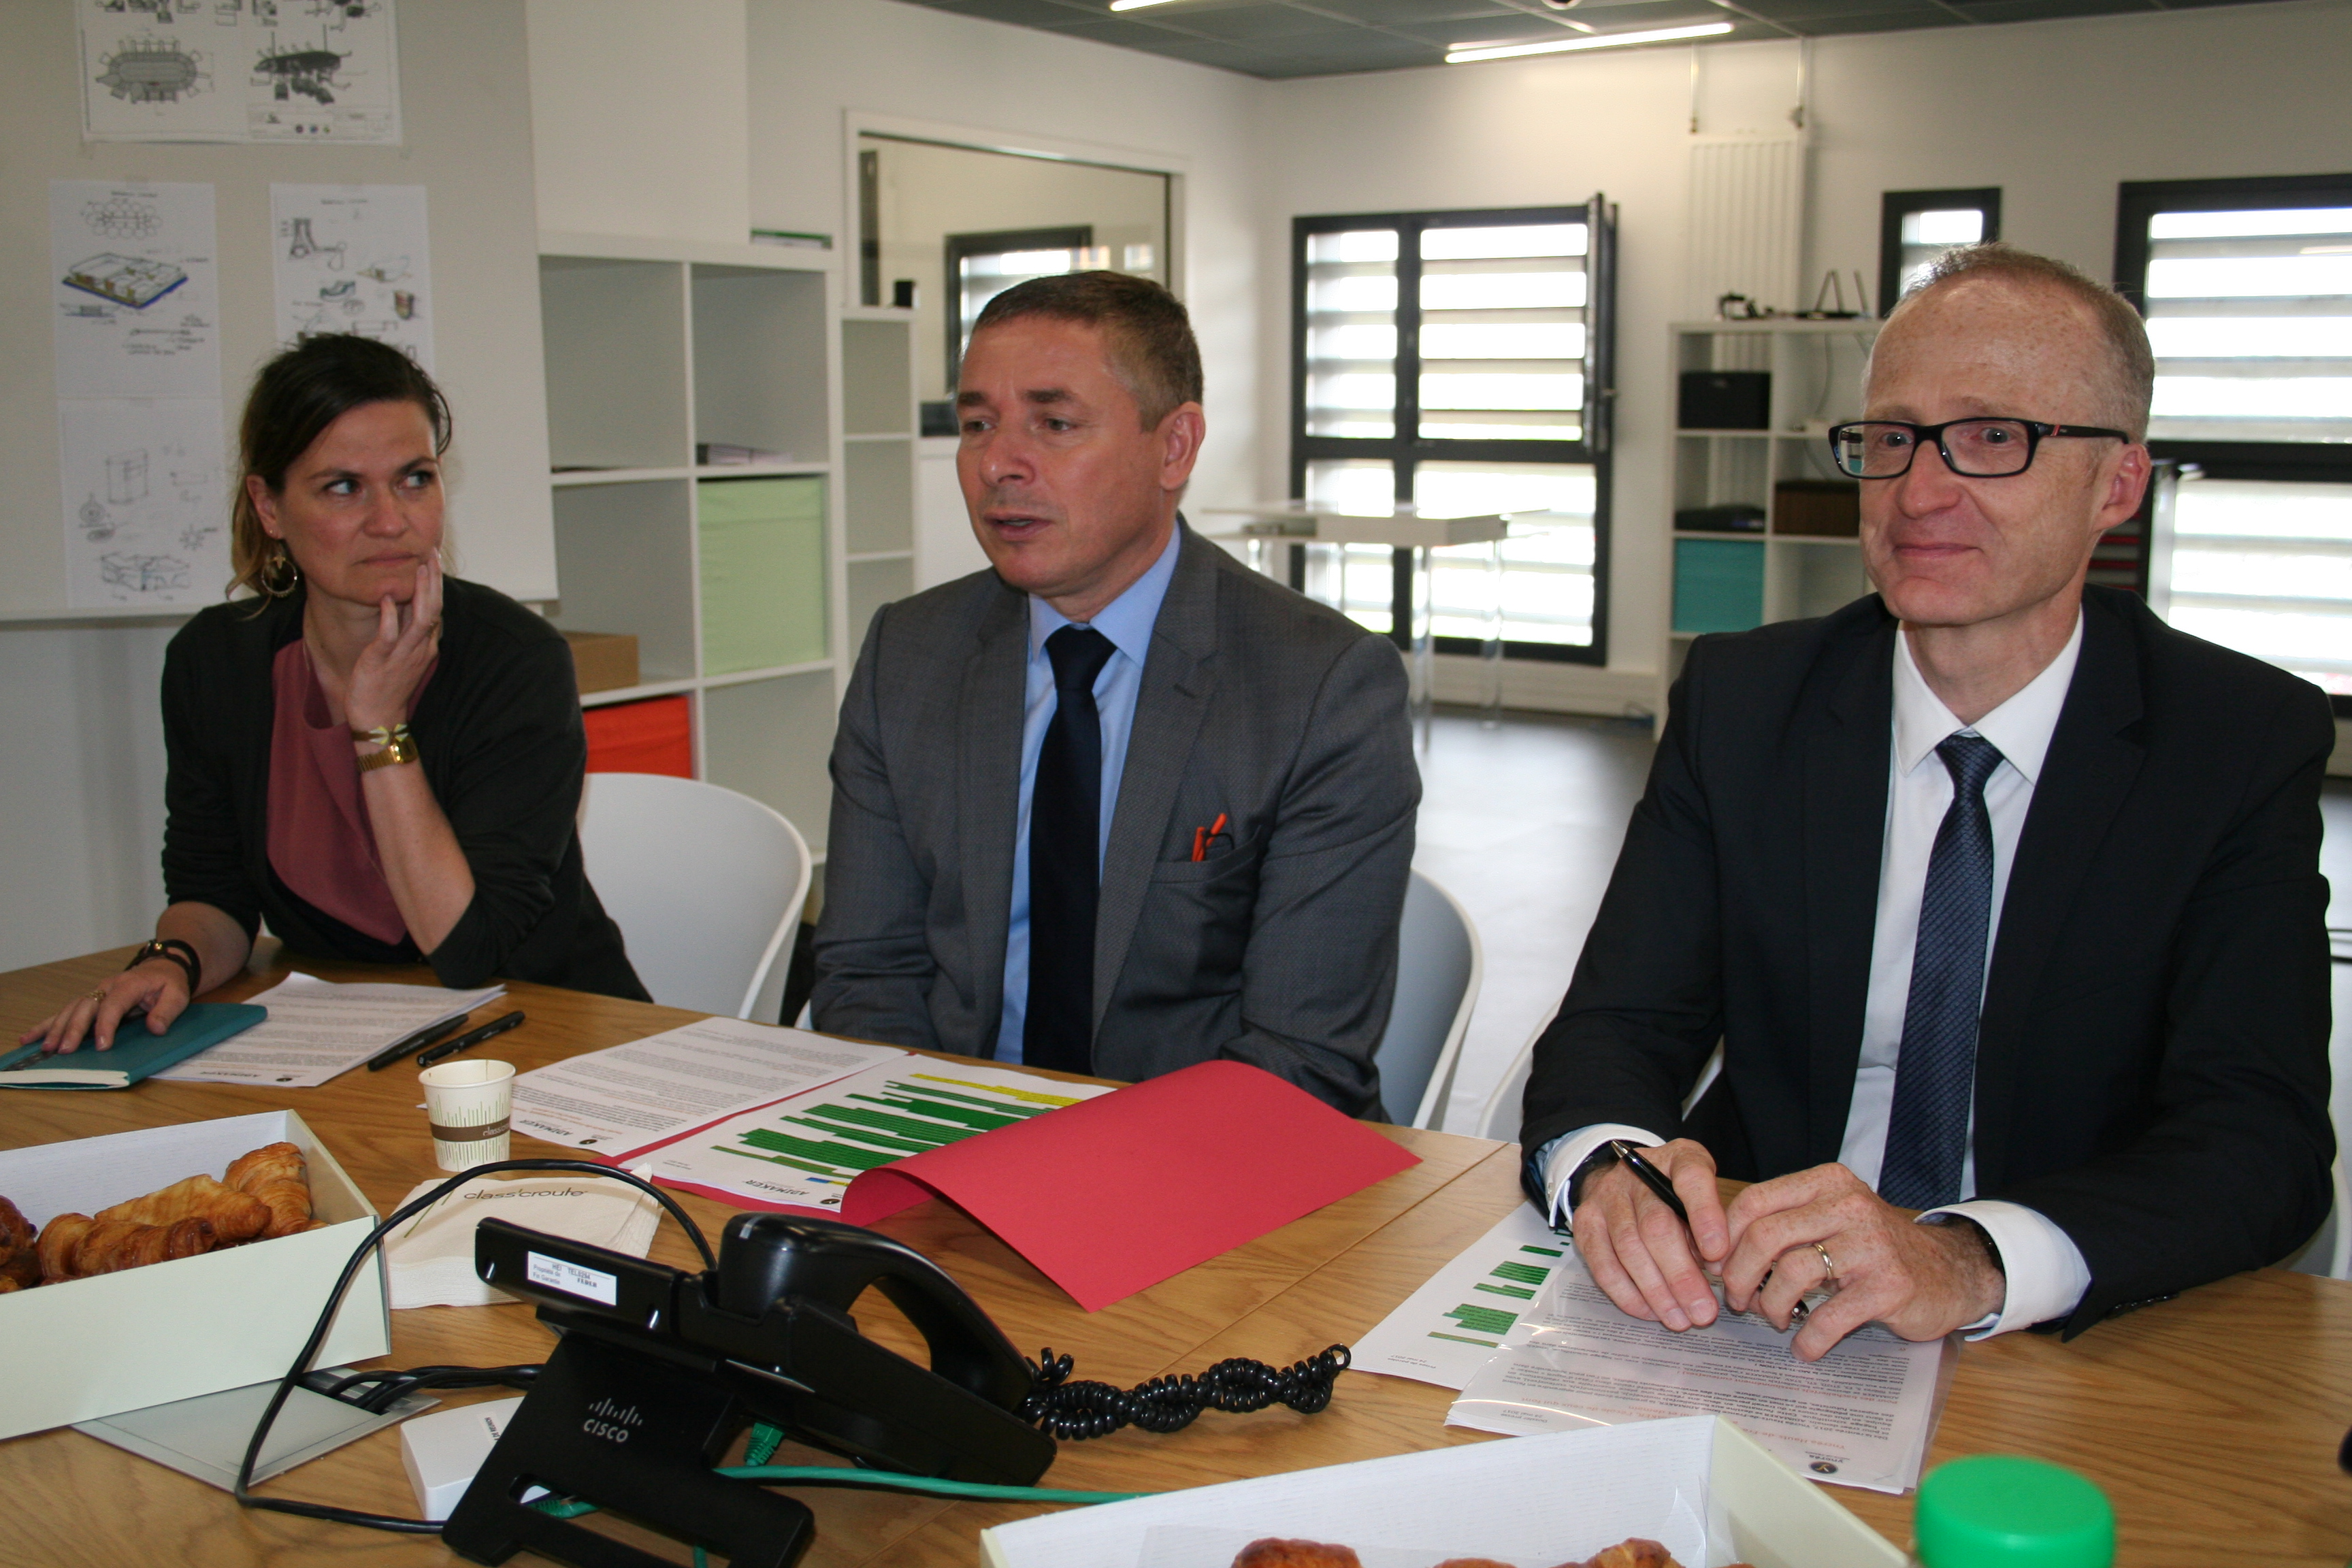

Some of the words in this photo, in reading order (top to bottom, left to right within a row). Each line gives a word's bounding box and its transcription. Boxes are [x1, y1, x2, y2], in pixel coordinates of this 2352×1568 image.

[464, 1187, 585, 1200] class'croute
[744, 1179, 811, 1196] ADIMAKER
[583, 1418, 629, 1442] CISCO
